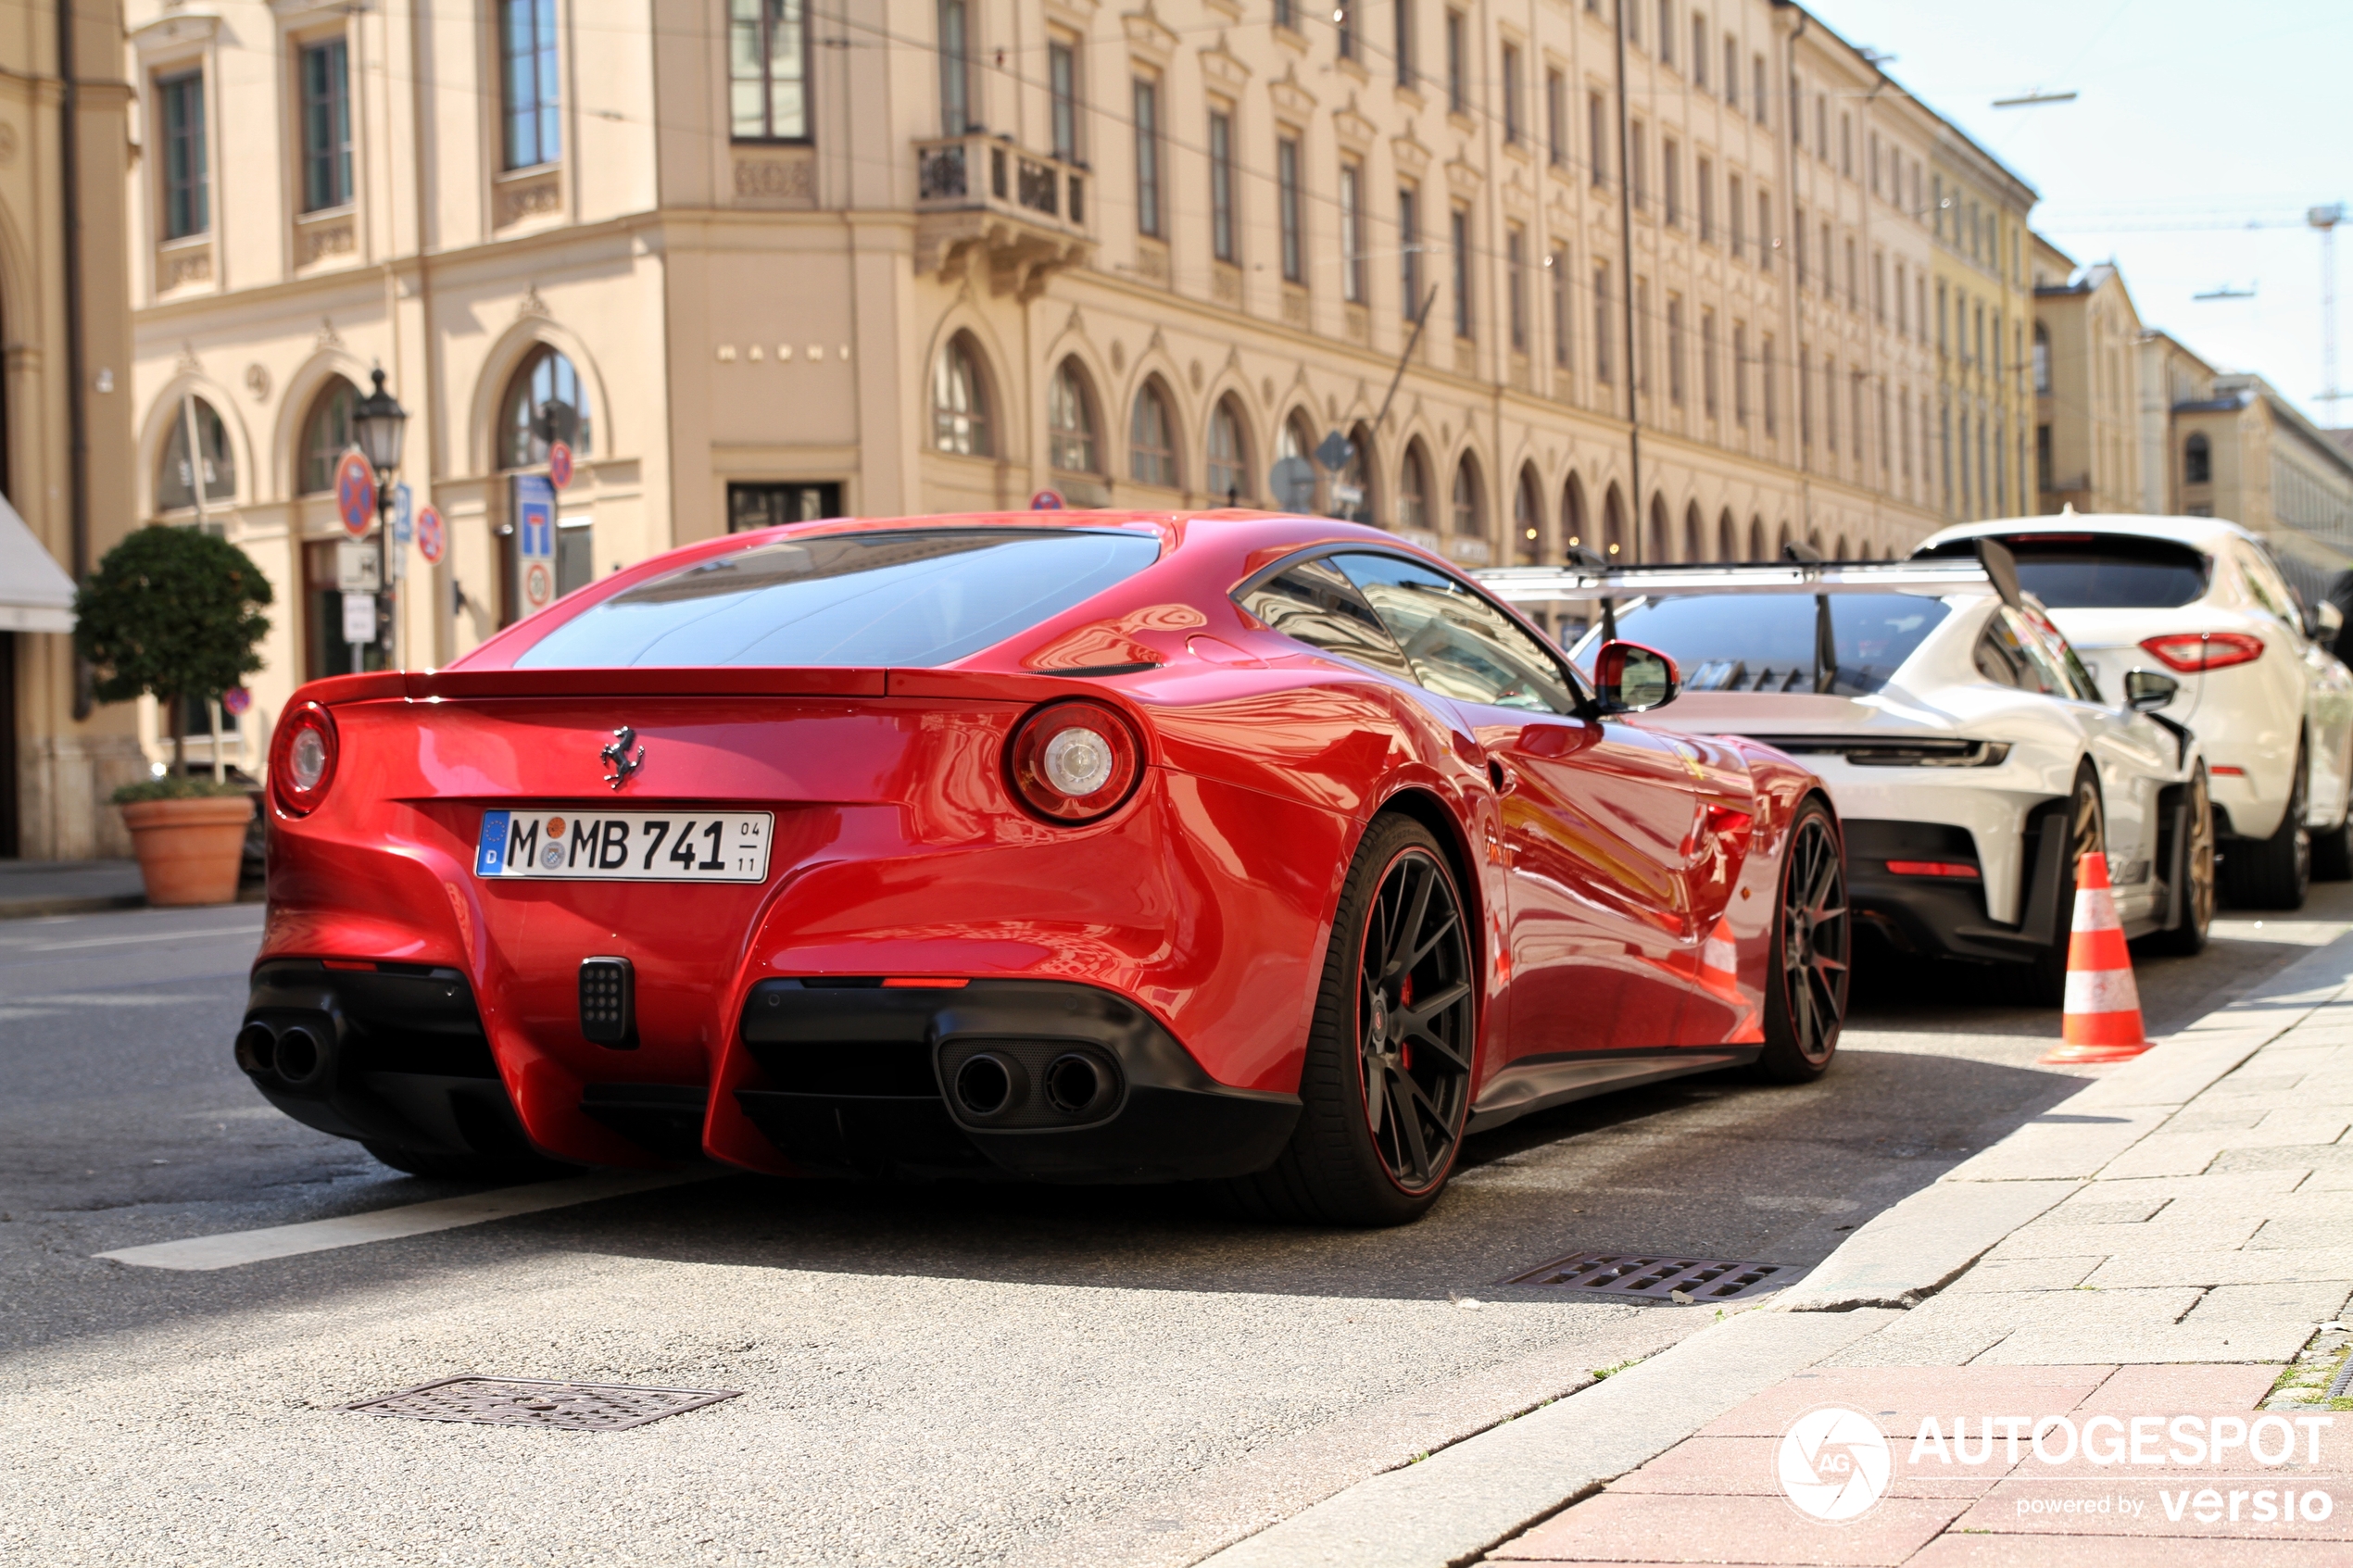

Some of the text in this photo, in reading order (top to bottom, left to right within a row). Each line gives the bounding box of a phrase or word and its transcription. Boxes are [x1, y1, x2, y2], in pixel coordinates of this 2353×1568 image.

[740, 822, 760, 836] 04
[507, 819, 725, 871] M MB 741
[485, 849, 497, 864] D
[738, 858, 755, 872] 11
